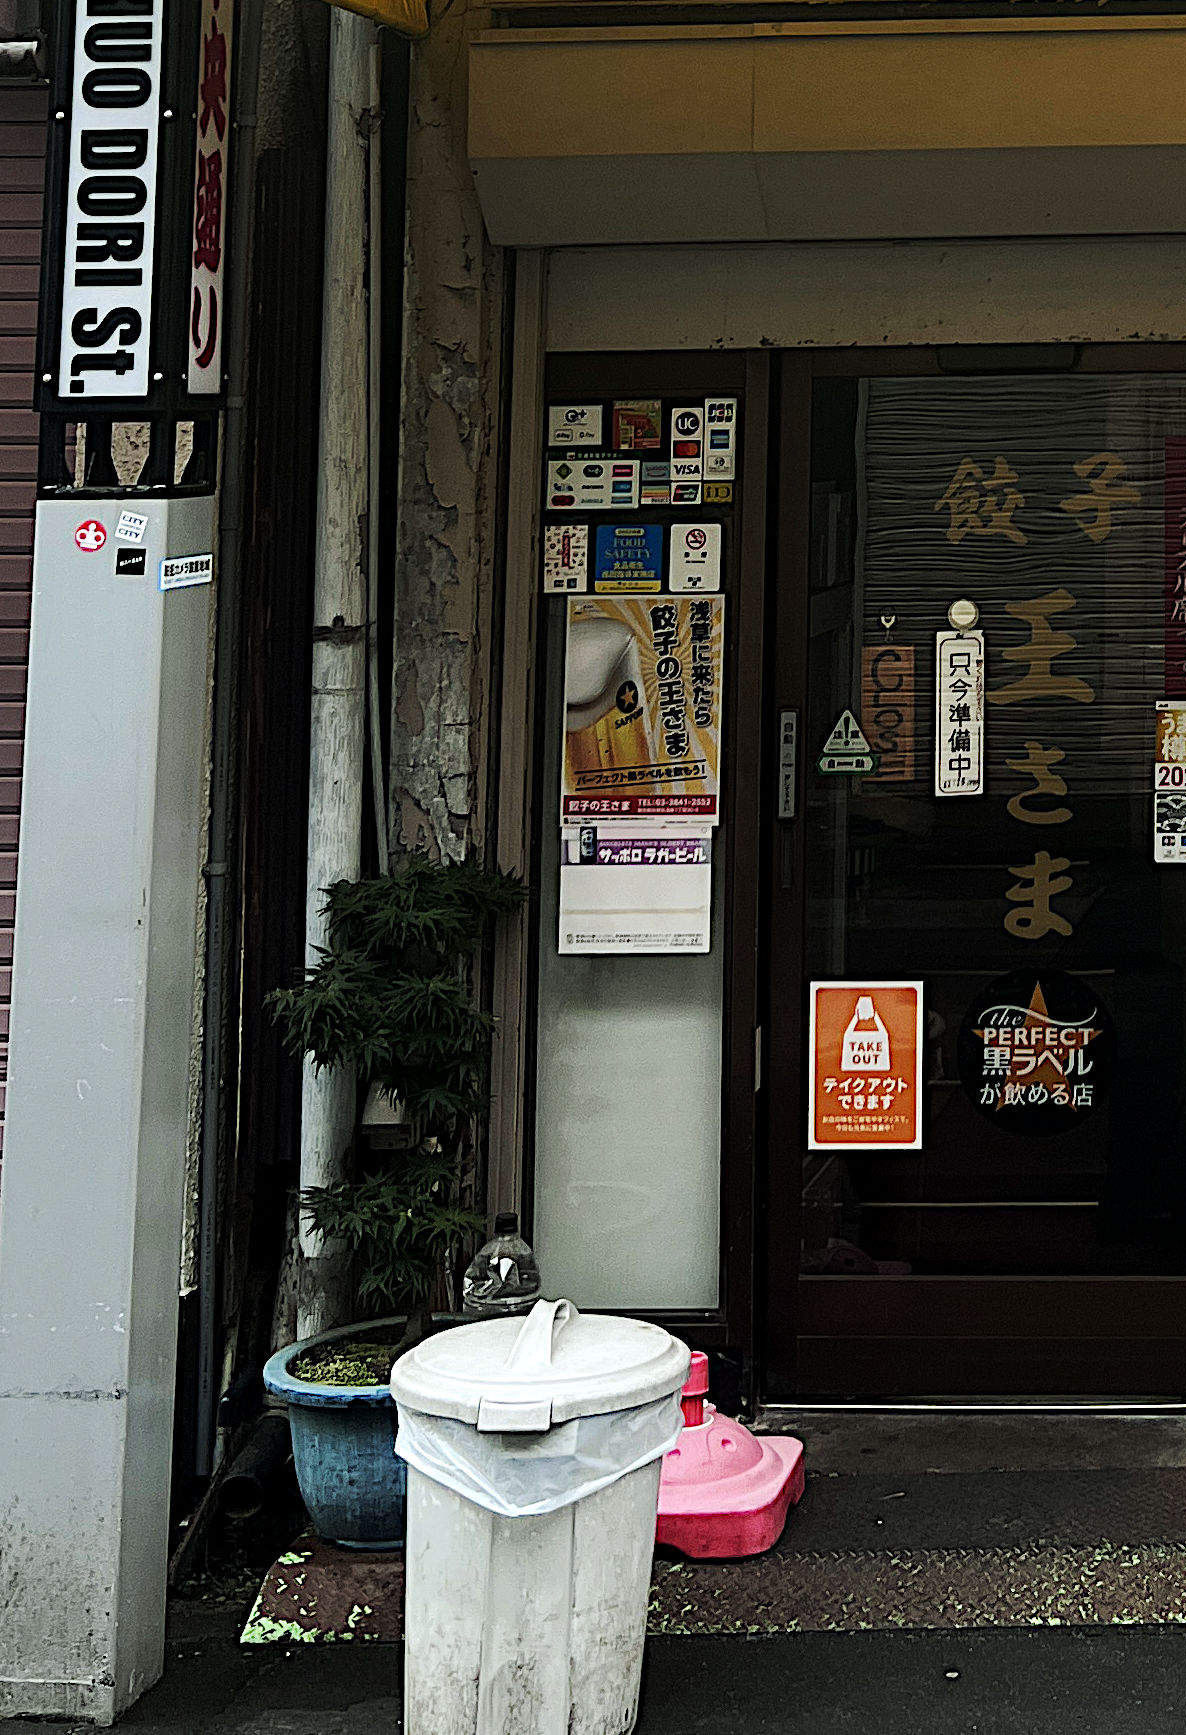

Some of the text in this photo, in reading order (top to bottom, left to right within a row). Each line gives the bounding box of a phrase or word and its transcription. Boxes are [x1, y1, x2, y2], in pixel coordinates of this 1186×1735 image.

[75, 129, 148, 287] DORI
[69, 306, 142, 394] St.
[678, 418, 698, 429] UC
[674, 465, 700, 474] VISA
[613, 538, 645, 547] FOOD
[604, 549, 651, 559] SAFETY
[690, 601, 713, 727] 浅草に来たら
[650, 604, 689, 758] 餃子の王さま
[948, 652, 973, 778] 只今準備中
[984, 1027, 1095, 1046] PERFECT
[849, 1041, 883, 1052] TAKE
[852, 1054, 880, 1065] OUT
[982, 1047, 1094, 1076] 黒ラベル
[823, 1076, 908, 1093] テイクアウト
[838, 1094, 895, 1110] できます
[980, 1082, 1094, 1106] が飲める店
